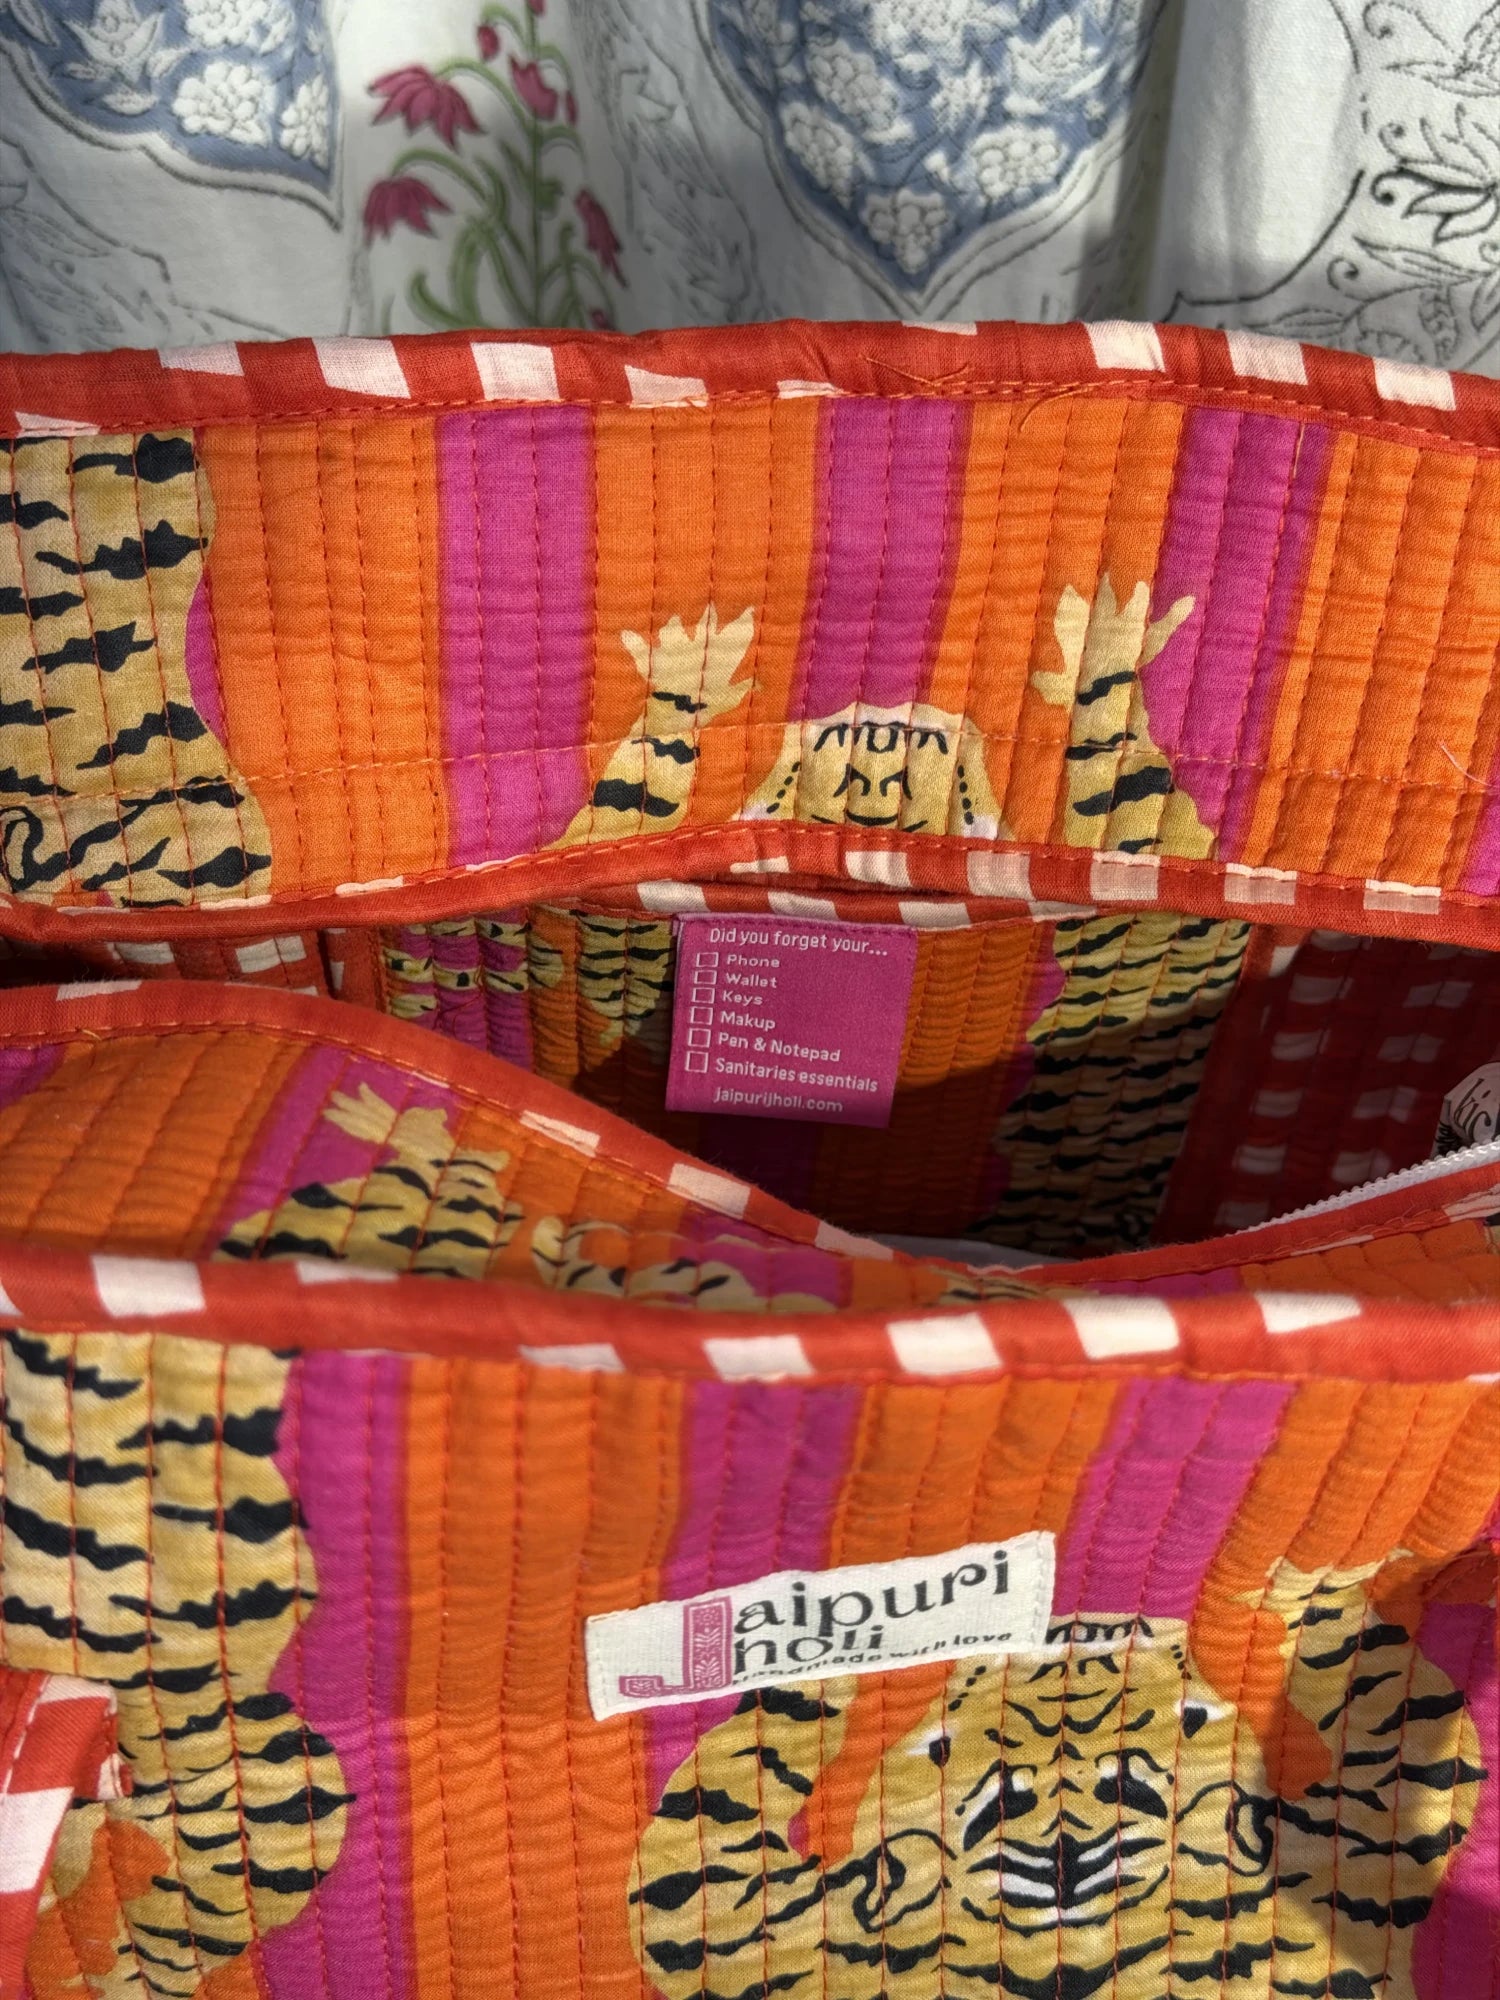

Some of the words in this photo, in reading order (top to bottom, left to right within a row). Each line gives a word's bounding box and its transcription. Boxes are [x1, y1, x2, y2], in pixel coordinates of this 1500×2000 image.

[710, 927, 736, 944] Did
[740, 931, 769, 946] you
[774, 931, 827, 951] forget
[832, 937, 888, 957] your...
[726, 954, 780, 968] Phone
[725, 972, 778, 989] Wallet
[722, 990, 763, 1006] Keys
[720, 1011, 776, 1032] Makup
[718, 1032, 748, 1049] Pen
[753, 1037, 767, 1052] &
[770, 1039, 841, 1062] Notepad
[715, 1058, 796, 1082] Sanitaries
[798, 1066, 879, 1093] essentials
[953, 1632, 1012, 1648] love
